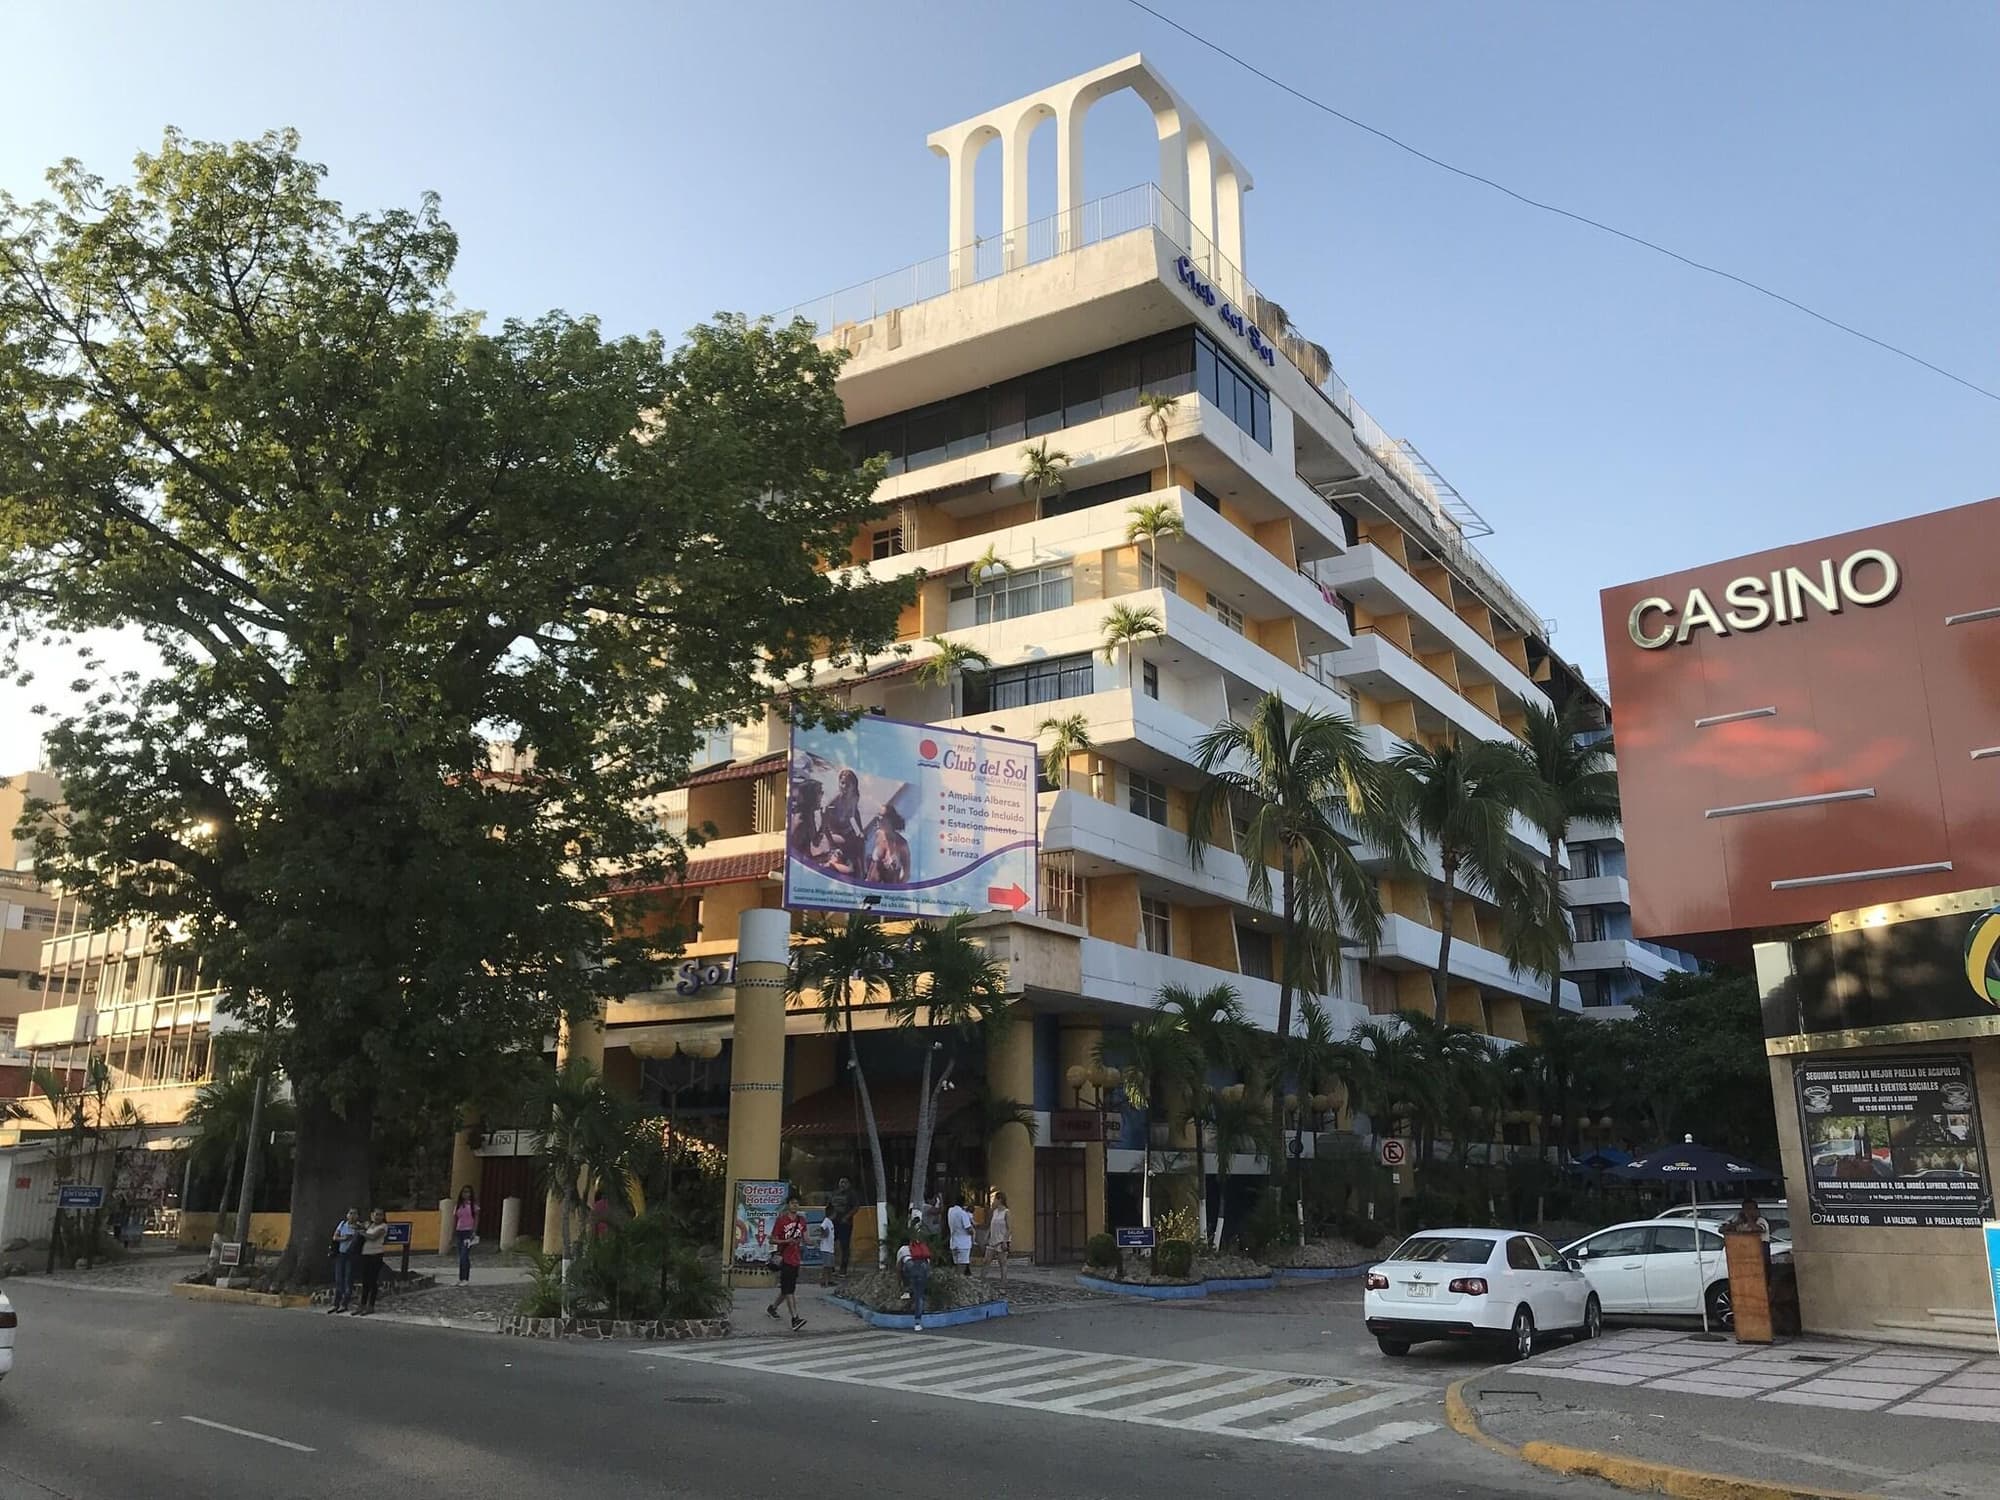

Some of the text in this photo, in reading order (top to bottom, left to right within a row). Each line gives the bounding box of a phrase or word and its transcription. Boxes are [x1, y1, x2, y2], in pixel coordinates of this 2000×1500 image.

[1177, 255, 1216, 306] Club
[1628, 548, 1902, 650] CASINO
[943, 749, 1028, 780] Club del Sol
[948, 790, 1021, 808] Amplias Albercas
[947, 804, 1025, 823] Plan Todo Incluido
[947, 819, 1018, 836] Estacionamiento
[947, 833, 981, 846] Salones
[947, 847, 980, 860] Terraza
[683, 953, 738, 996] Sol
[1805, 1066, 1960, 1081] SEGUIMOS SIENDO LA MEJOR PAELLA DE ACAPULCO
[1832, 1083, 1874, 1094] RESTAURANTE
[1880, 1082, 1908, 1092] EVENTOS
[1908, 1081, 1939, 1091] SOCIALES
[743, 1184, 785, 1196] Ofertas
[1950, 1182, 1967, 1190] COSTA
[745, 1195, 781, 1205] Hoteles
[746, 1210, 778, 1218] Informes
[1821, 1213, 1836, 1224] 744
[1850, 1214, 1859, 1224] 07
[1883, 1215, 1918, 1225] LA VALENCIA
[1925, 1216, 1934, 1225] LA
[1934, 1216, 1956, 1226] PAELLA
[1956, 1216, 1964, 1226] DE
[1964, 1217, 1981, 1226] COSTA
